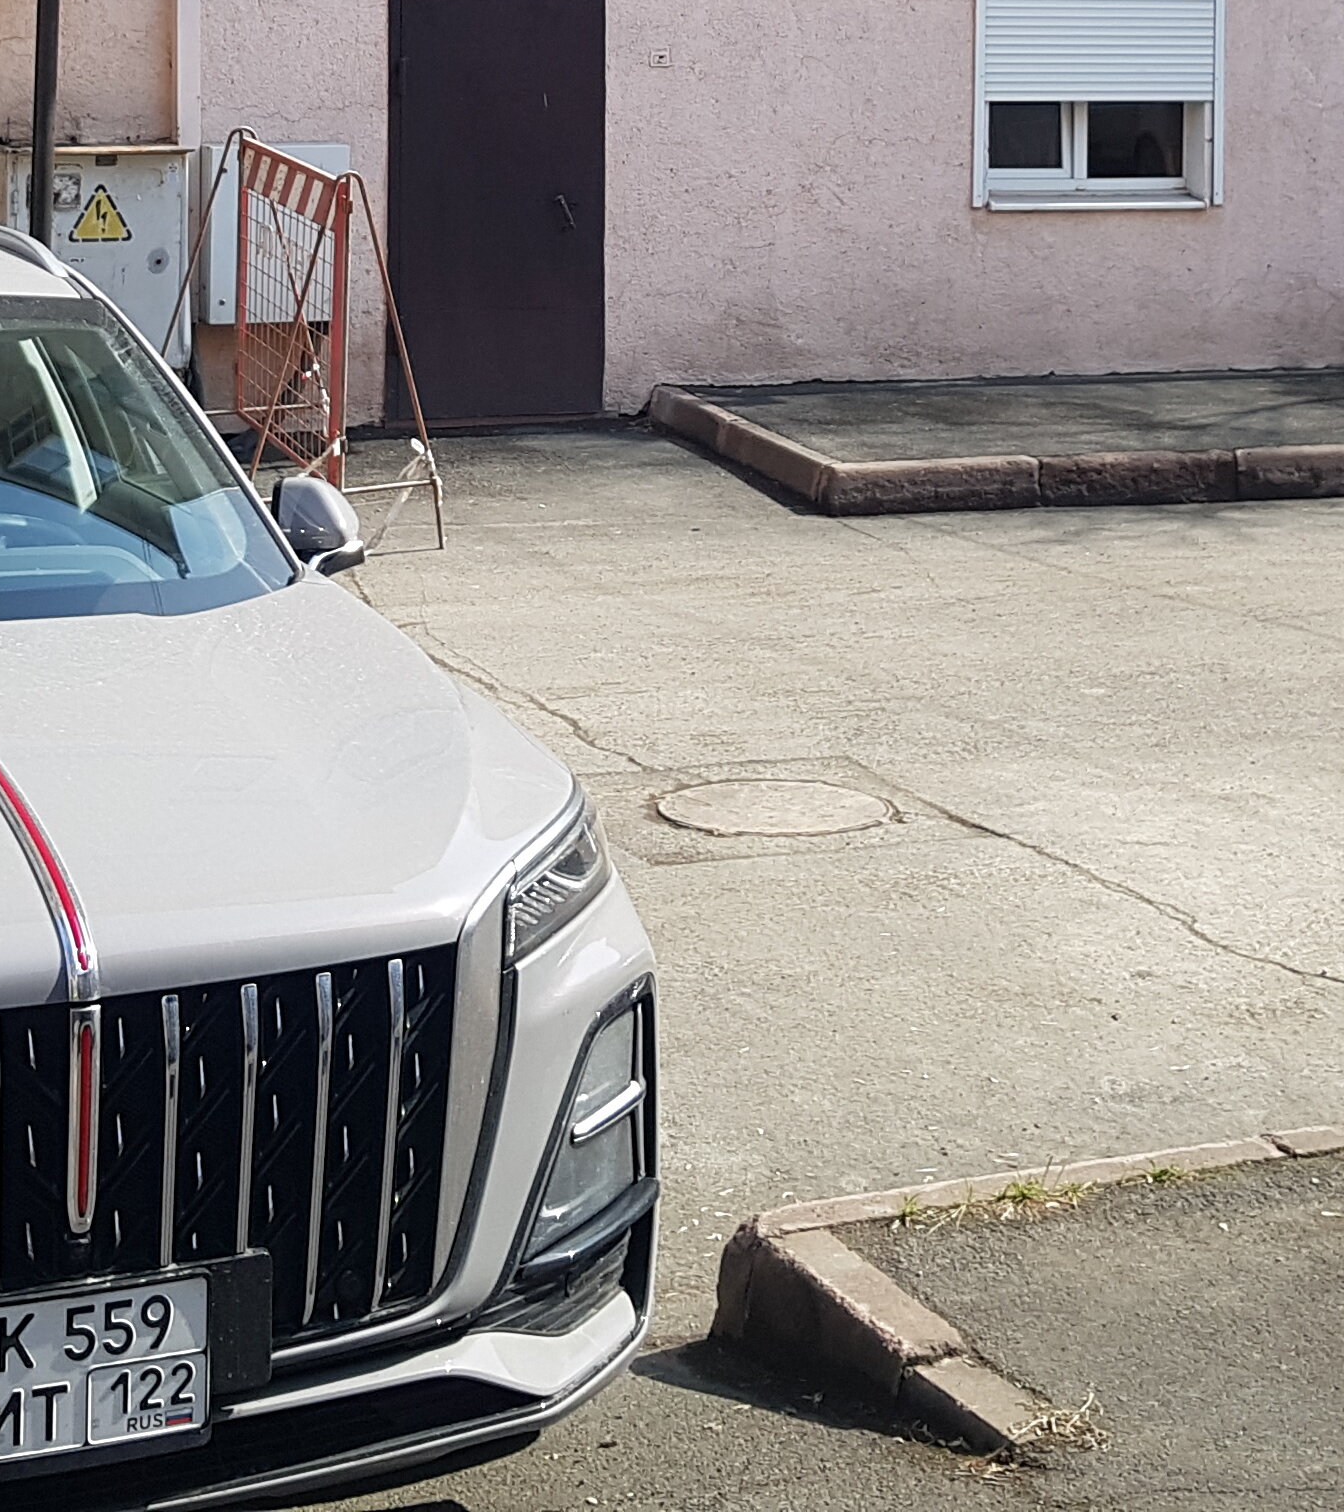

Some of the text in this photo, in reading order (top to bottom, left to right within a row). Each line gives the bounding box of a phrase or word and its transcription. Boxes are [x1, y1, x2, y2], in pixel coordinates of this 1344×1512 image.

[64, 1294, 173, 1361] 559
[110, 1361, 196, 1414] 122
[126, 1413, 163, 1432] RUS
